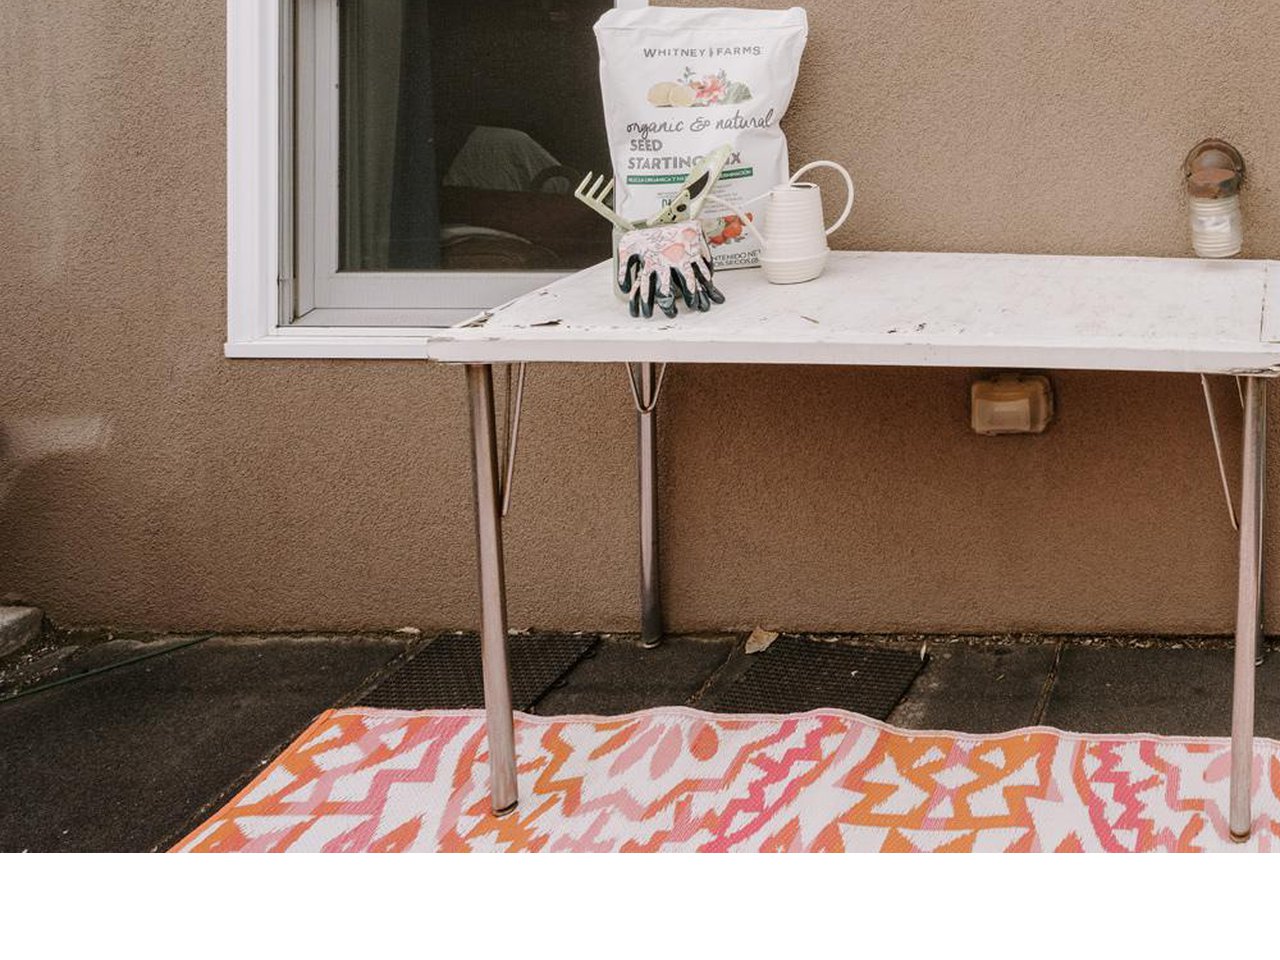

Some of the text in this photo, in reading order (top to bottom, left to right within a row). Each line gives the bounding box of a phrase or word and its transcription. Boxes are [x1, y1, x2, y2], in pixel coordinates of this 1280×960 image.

[643, 46, 761, 58] WHITNEY FARMS
[626, 108, 774, 140] organic & natural
[629, 139, 663, 152] SEED
